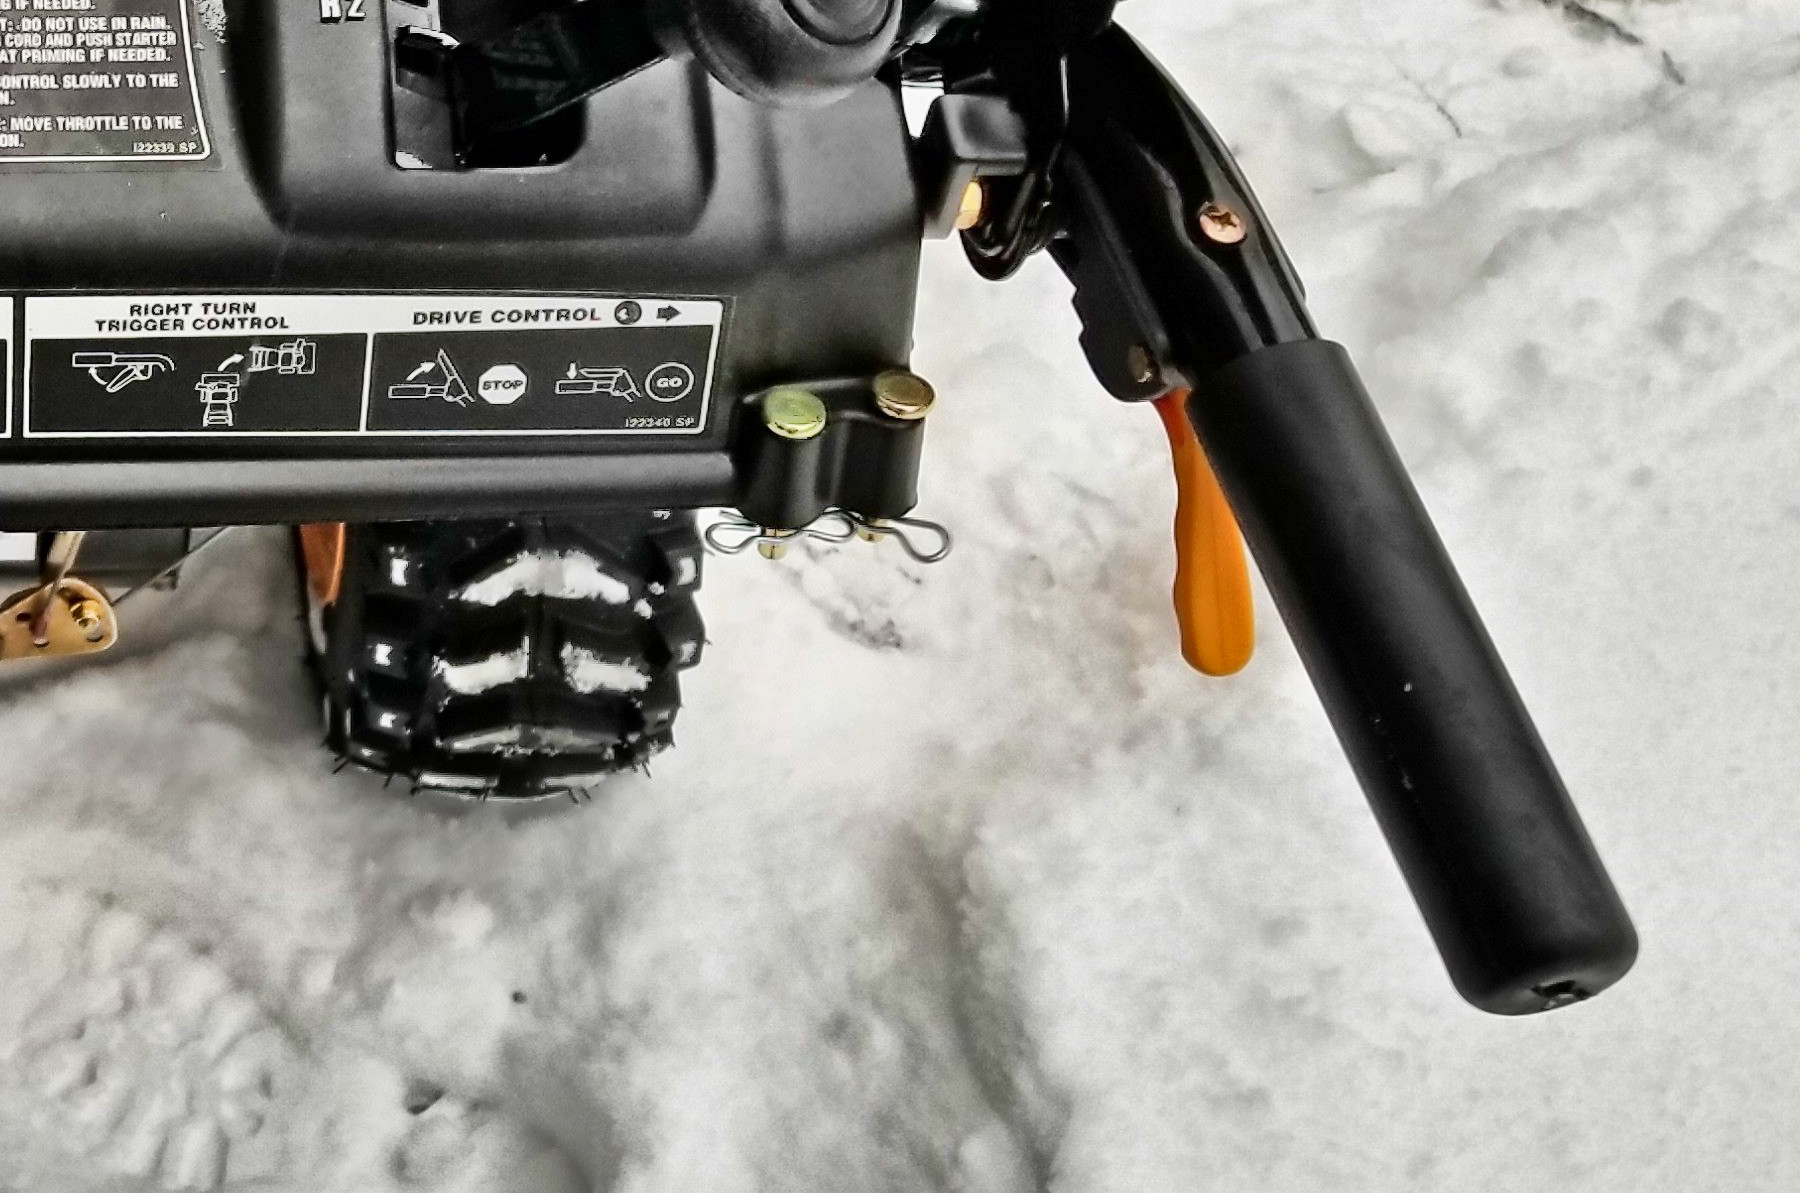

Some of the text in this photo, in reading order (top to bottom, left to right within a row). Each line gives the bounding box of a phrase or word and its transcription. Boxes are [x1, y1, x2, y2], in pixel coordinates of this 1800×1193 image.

[21, 16, 42, 31] DO
[45, 16, 75, 31] NOT
[78, 16, 107, 30] USE
[111, 16, 127, 30] IN
[130, 15, 172, 30] RAIN.
[5, 33, 41, 48] CORD
[45, 32, 73, 47] AND
[76, 32, 113, 46] PUSH
[115, 31, 177, 46] STARTER
[22, 48, 85, 63] PRIMING
[89, 48, 106, 63] IF
[108, 47, 173, 62] NEEDED.
[62, 73, 122, 88] SLOWLY
[126, 73, 146, 88] TO
[149, 72, 179, 88] THE
[10, 116, 52, 131] MOVE
[56, 115, 129, 131] THROTTLE
[132, 115, 152, 130] TO
[155, 115, 184, 130] THE
[129, 302, 256, 318] RIGHT TURN
[414, 307, 601, 326] DRIVE CONTROL
[95, 316, 289, 332] TRIGGER CONTROL
[483, 379, 524, 392] STOP
[656, 376, 682, 389] GO
